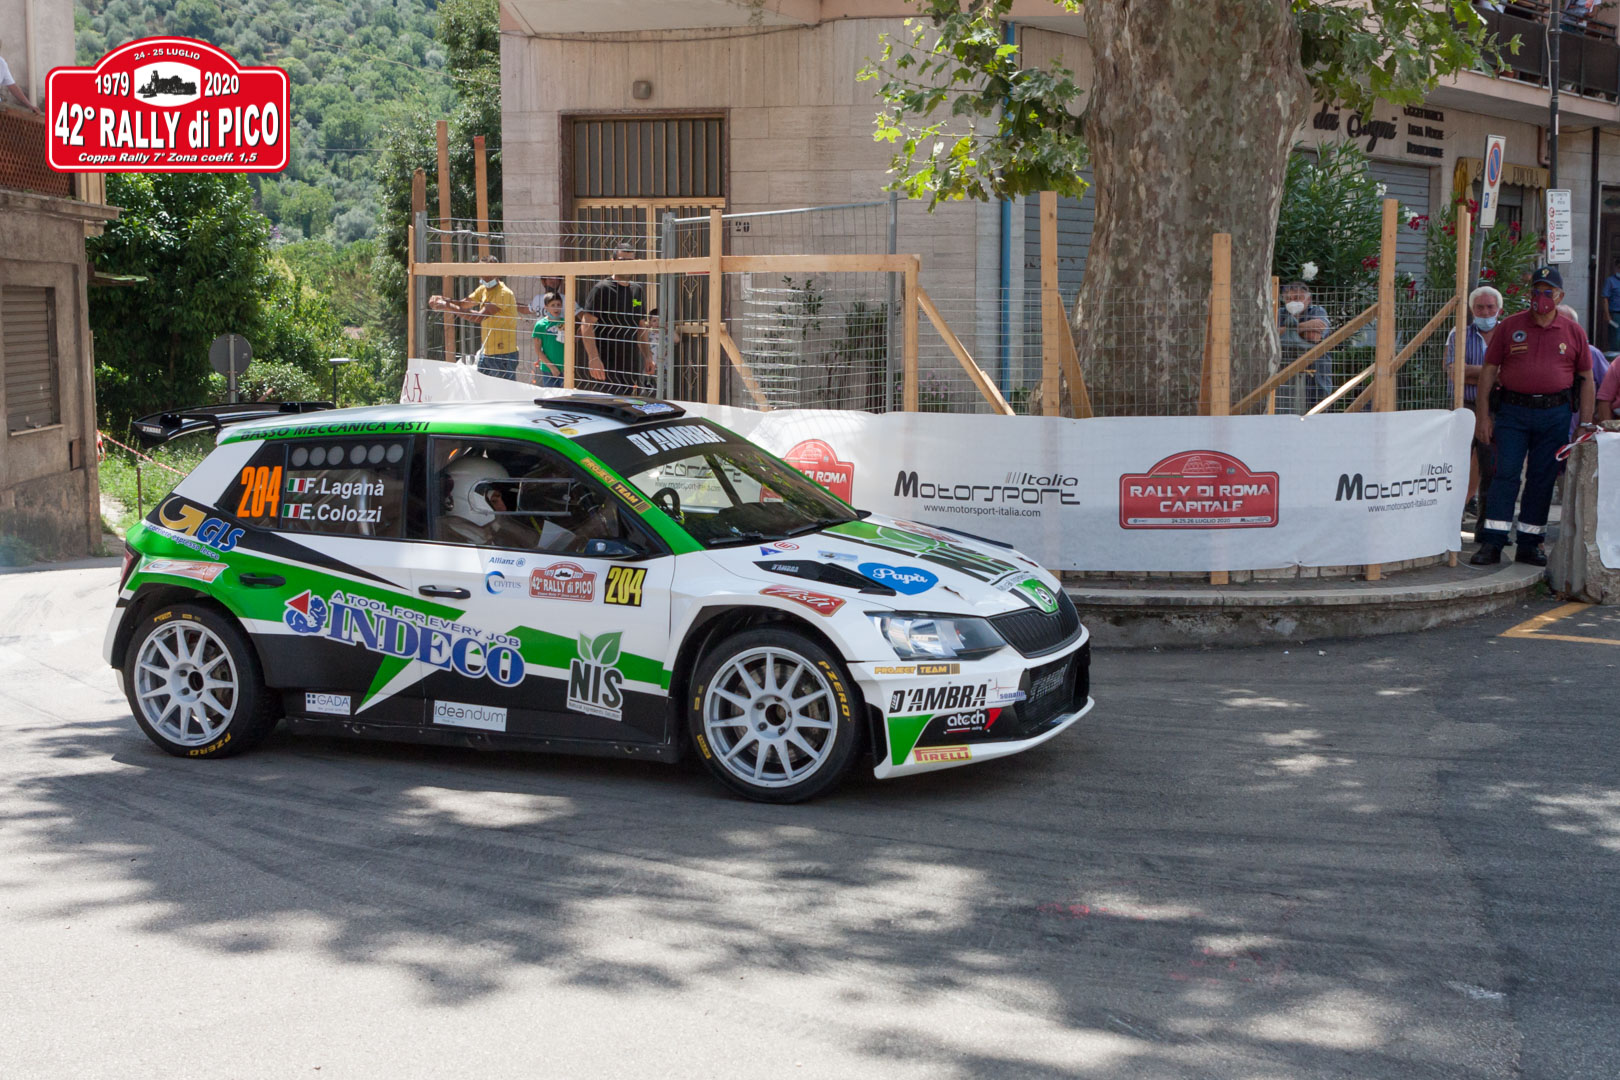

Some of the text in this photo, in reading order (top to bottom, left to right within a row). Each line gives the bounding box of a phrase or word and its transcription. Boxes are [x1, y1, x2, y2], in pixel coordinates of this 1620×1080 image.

[735, 221, 750, 232] 20
[240, 421, 431, 440] BASSO MECCANICA ASTI
[626, 425, 727, 456] D'AMBRA
[581, 457, 639, 503] PROJECT TEAM
[816, 471, 848, 483] ROMA
[1021, 472, 1079, 487] Italia
[236, 466, 282, 518] 204
[304, 477, 385, 499] F.Laganà
[894, 470, 1081, 505] Motorsport
[1130, 484, 1271, 497] RALLY DI ROMA
[1335, 473, 1452, 501] Motorsport
[299, 503, 382, 523] E.Colozzi
[924, 504, 1041, 518] www.motorsport-italia.com
[1160, 500, 1243, 513] CAPITALE
[1368, 498, 1437, 512] www.motorsport-italia.com
[171, 532, 200, 551] espresso
[196, 517, 246, 553] GLS
[489, 557, 515, 565] Allianz
[493, 580, 522, 589] CIVITUS
[543, 579, 566, 593] RALLY
[567, 581, 574, 593] di
[575, 580, 592, 594] PICO
[605, 567, 646, 605] 204
[333, 592, 520, 647] A TOOL FOR EVERY JOB
[327, 601, 525, 686] INDECO
[874, 665, 947, 674] PROJECT TEAM
[570, 660, 623, 708] NIS
[317, 695, 349, 707] GADA
[889, 684, 987, 714] D'AMBRA
[435, 701, 504, 723] ideandum
[947, 709, 986, 727] atech
[914, 746, 969, 761] PIRELLI
